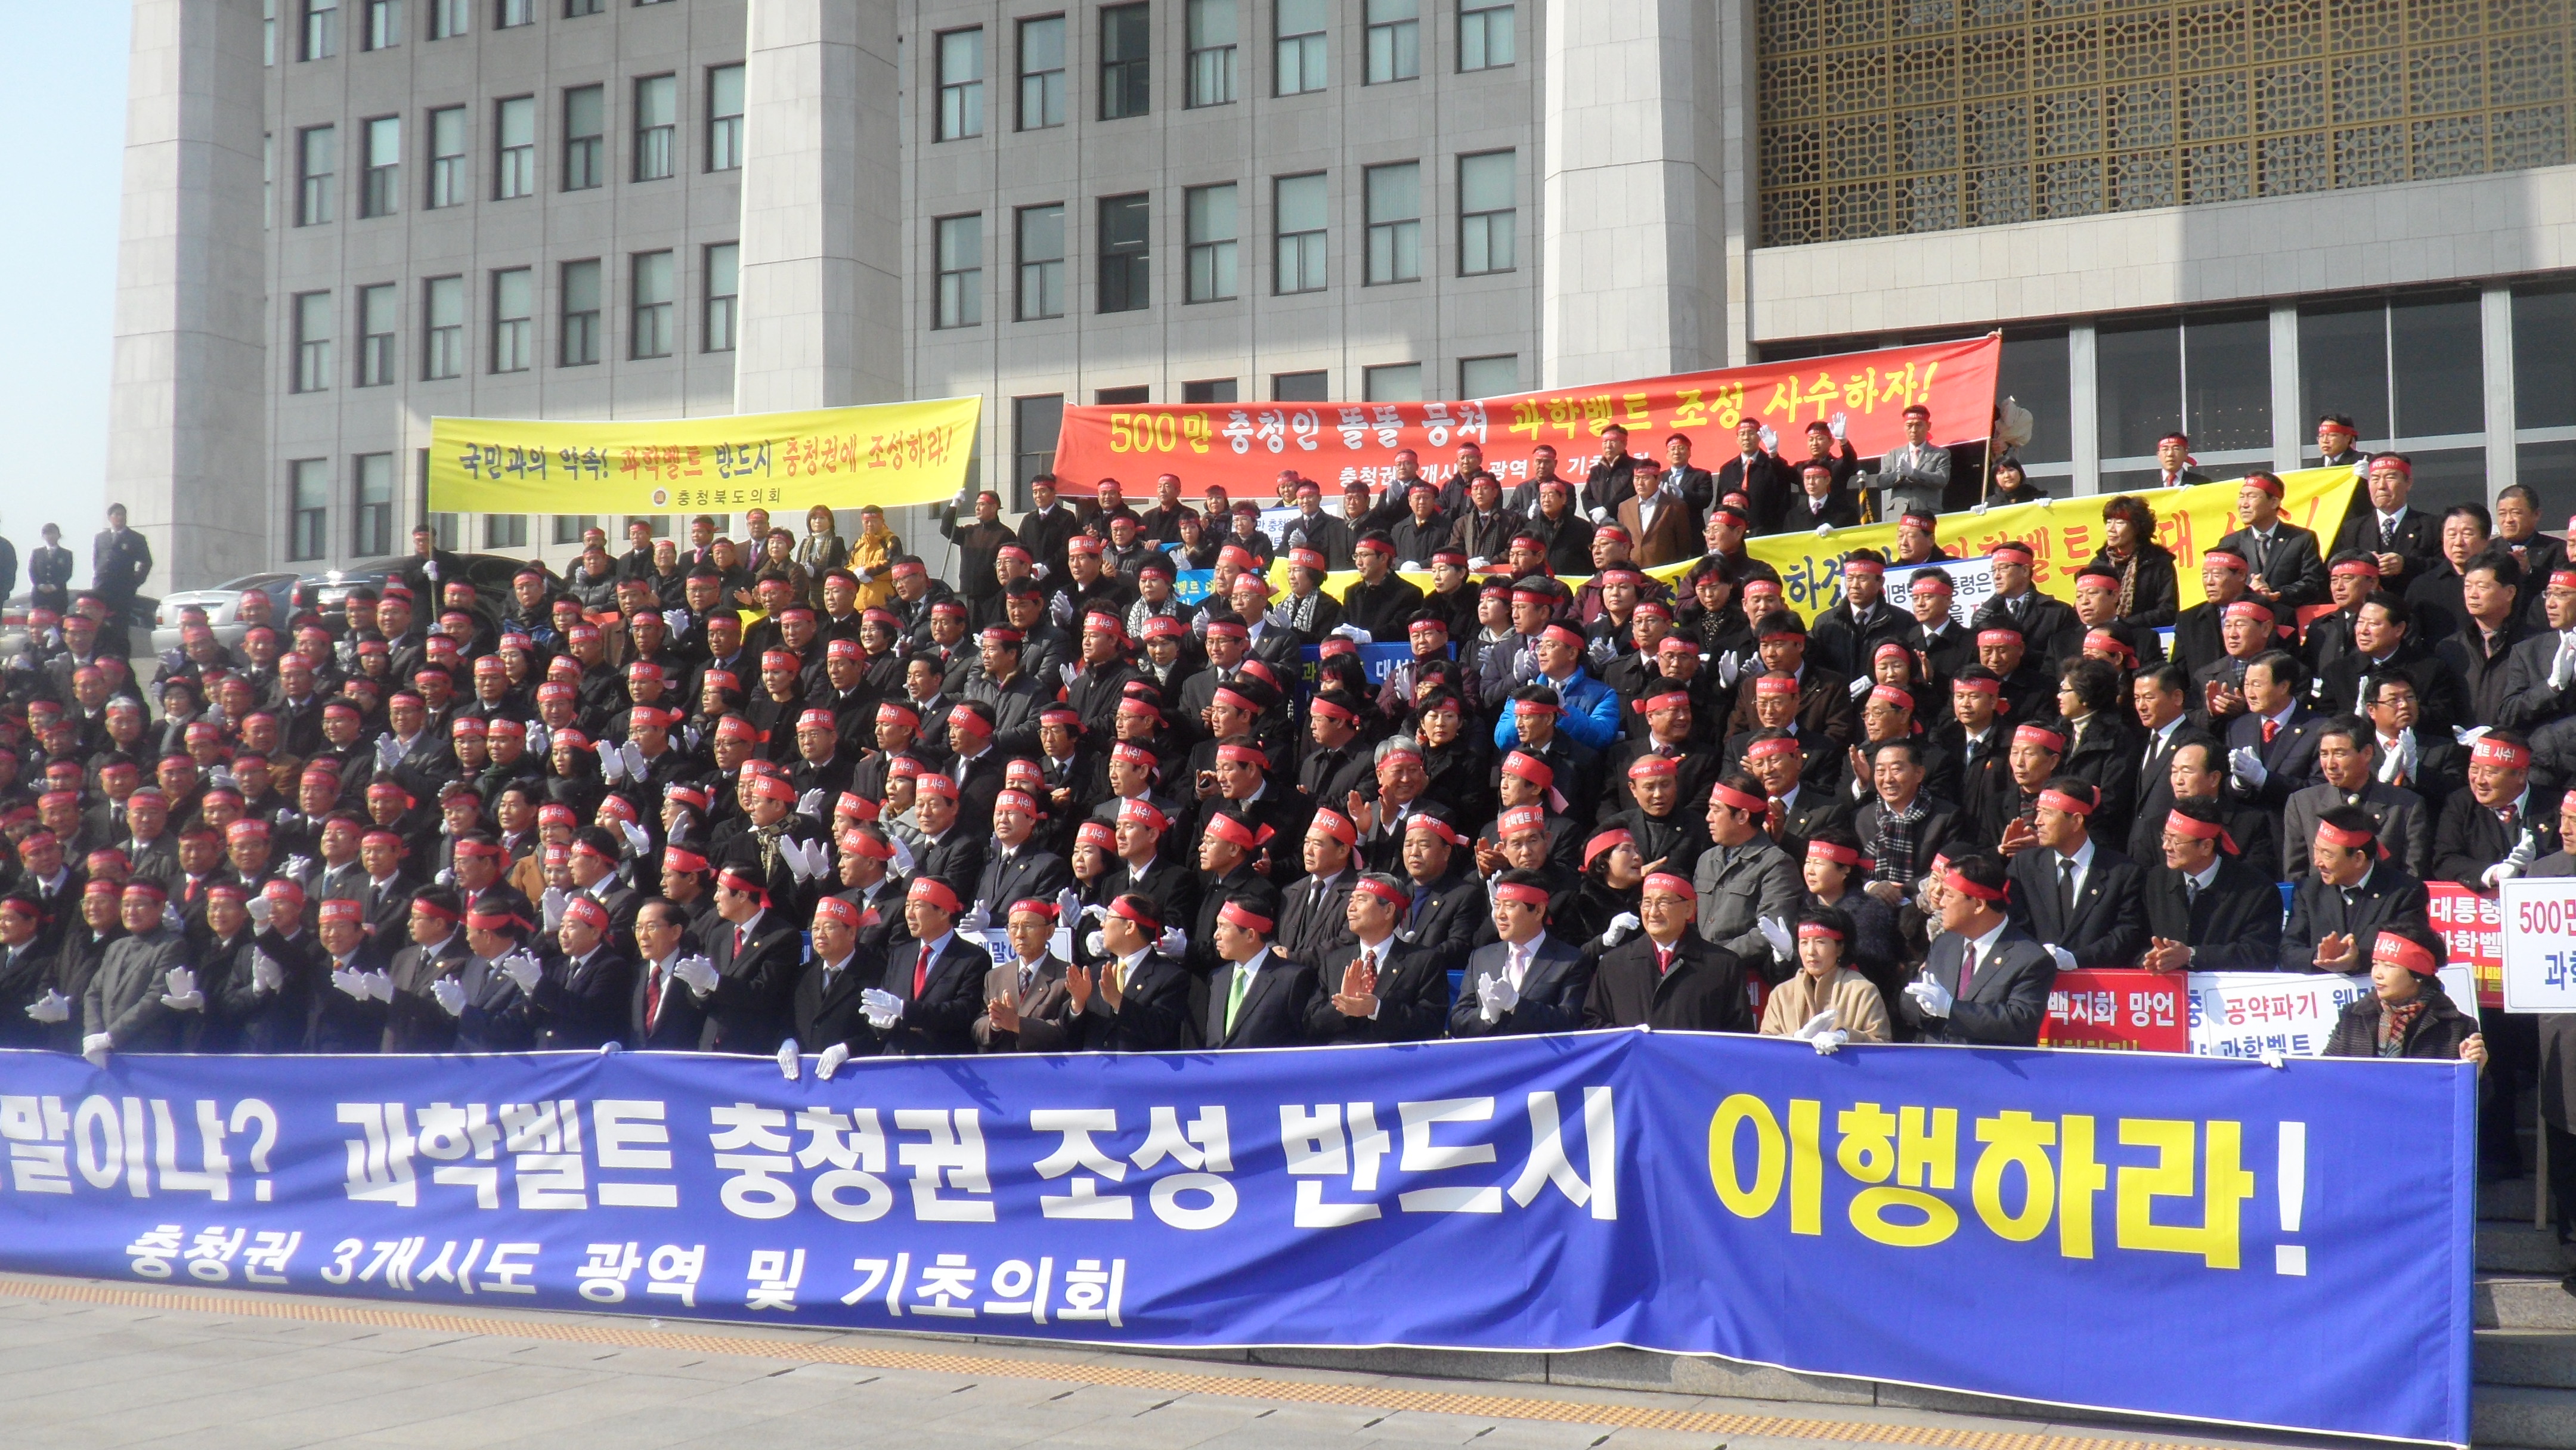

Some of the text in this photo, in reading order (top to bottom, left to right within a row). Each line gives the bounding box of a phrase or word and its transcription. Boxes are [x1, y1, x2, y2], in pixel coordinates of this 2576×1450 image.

[1110, 361, 1939, 454] 500만 충청인 똘똘 뭉쳐 과학벨트 조성 사수하자!
[459, 427, 952, 481] 국민과의 약속! 과학벨트 반드시 충청권에 조성하라!
[1489, 460, 1527, 479] 광역
[677, 488, 781, 506] 충청북도의회
[1300, 554, 1313, 563] 사수!
[1246, 578, 1259, 588] 사수!
[1100, 618, 1113, 628] 사수!
[1153, 621, 1168, 630] 사수!
[840, 644, 854, 654] 사수!
[771, 655, 782, 665] 사수!
[638, 666, 651, 674] 사수!
[711, 673, 725, 682] 사수!
[637, 711, 650, 720] 사수!
[817, 713, 831, 724] 사수!
[886, 708, 898, 719] 사수!
[954, 708, 968, 721] 사수!
[724, 722, 738, 731] 사수!
[568, 733, 581, 742] 사수!
[1124, 747, 1140, 759] 사수!
[2494, 747, 2515, 762] 사수!
[899, 761, 914, 772] 사수!
[1027, 767, 1041, 777] 사수!
[756, 781, 771, 791] 사수!
[930, 779, 946, 791] 사수!
[609, 802, 626, 816] 사수!
[847, 800, 860, 811] 사수!
[1017, 797, 1031, 809] 사수!
[550, 808, 565, 818] 사수!
[1133, 807, 1150, 820] 사수!
[1321, 815, 1339, 831] 사수!
[1423, 816, 1440, 828] 사수!
[1503, 812, 1530, 828] 과학벨트
[1089, 829, 1106, 841] 사수!
[846, 836, 860, 847] 사수!
[915, 884, 930, 895] 사수!
[831, 903, 847, 917] 사수!
[2380, 937, 2401, 958] 사수!
[577, 964, 595, 978] 사수!
[2048, 991, 2175, 1027] 백지화 망언
[2226, 991, 2318, 1025] 공약파기
[336, 1099, 677, 1210] 과학벨트
[709, 1103, 995, 1222] 충청권
[1030, 1105, 1238, 1230] 조성
[1280, 1086, 1617, 1228] 반드시
[1708, 1093, 2307, 1277] 이행하라!
[126, 1223, 1126, 1328] 충청권 3개시도 광역 및 기초의회
